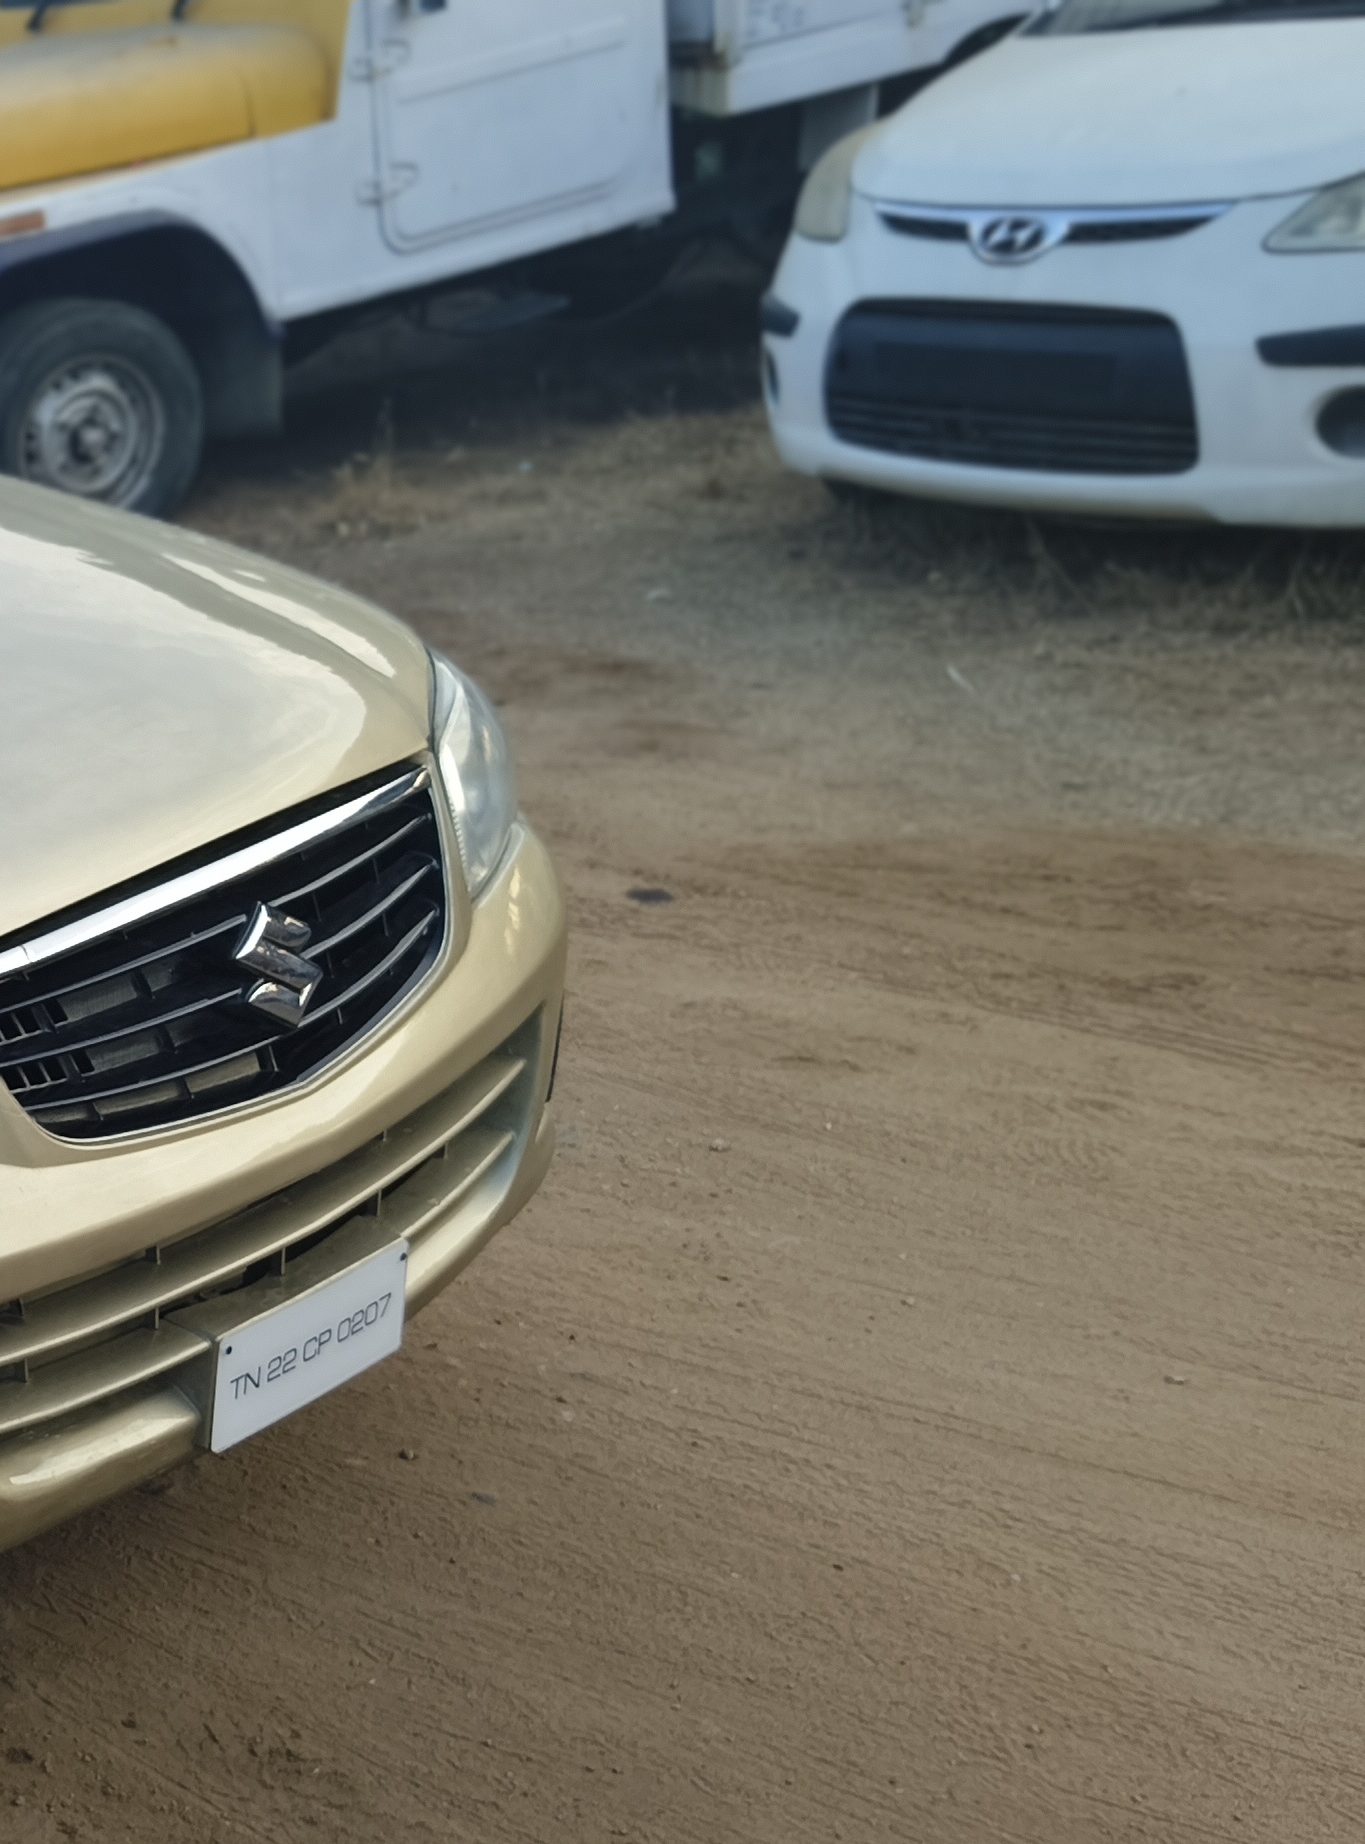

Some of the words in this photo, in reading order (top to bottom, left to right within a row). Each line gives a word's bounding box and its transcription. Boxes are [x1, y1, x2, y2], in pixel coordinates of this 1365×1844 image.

[230, 1366, 261, 1400] TN
[267, 1348, 297, 1383] 22
[303, 1328, 332, 1362] CP
[337, 1292, 392, 1343] 0207
